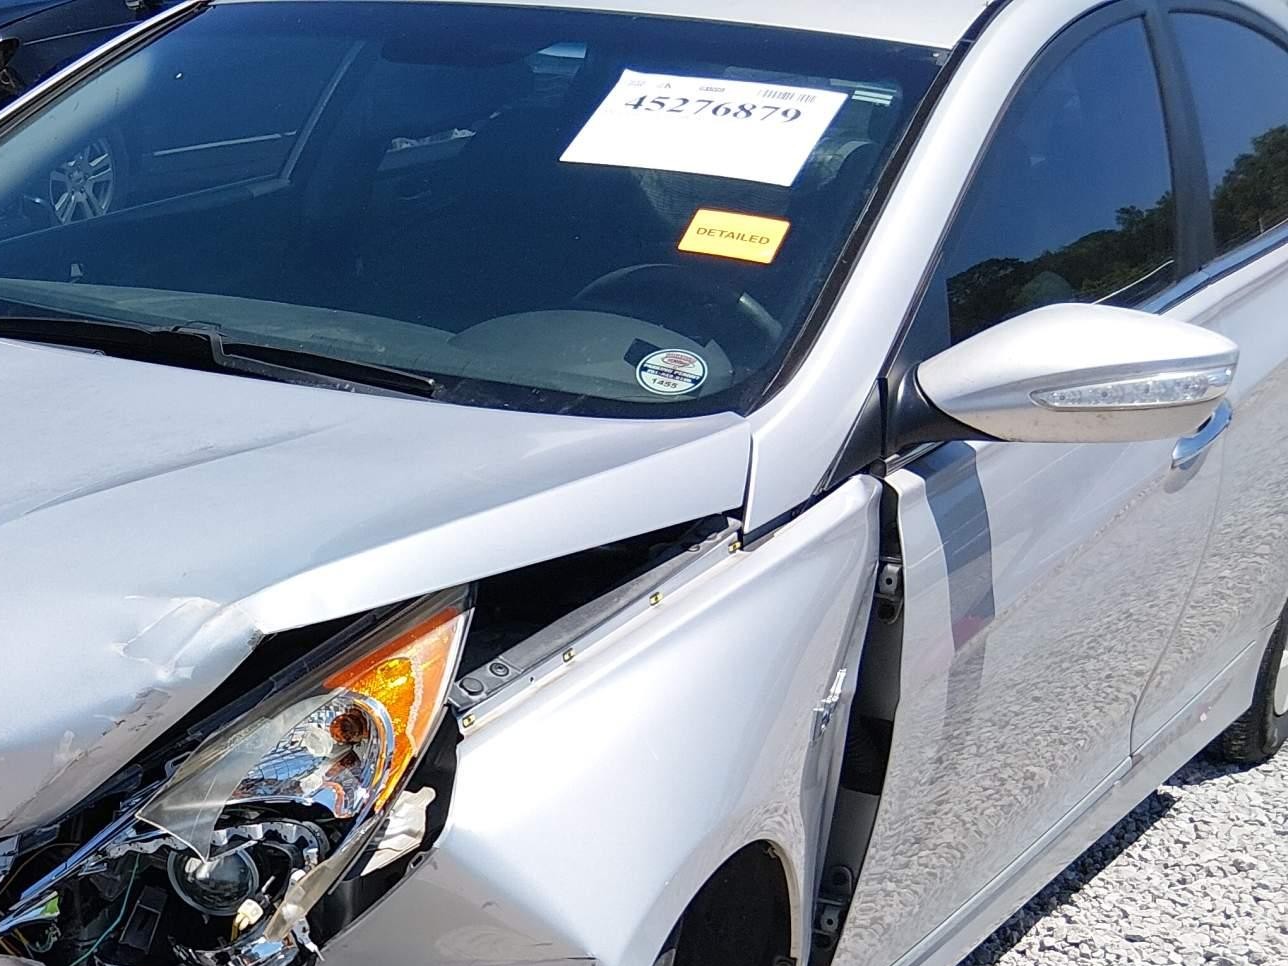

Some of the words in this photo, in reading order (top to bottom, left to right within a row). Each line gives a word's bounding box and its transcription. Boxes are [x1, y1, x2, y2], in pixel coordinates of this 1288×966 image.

[624, 95, 802, 123] 45276879
[696, 227, 770, 245] DETAILED
[652, 378, 678, 389] 1455
